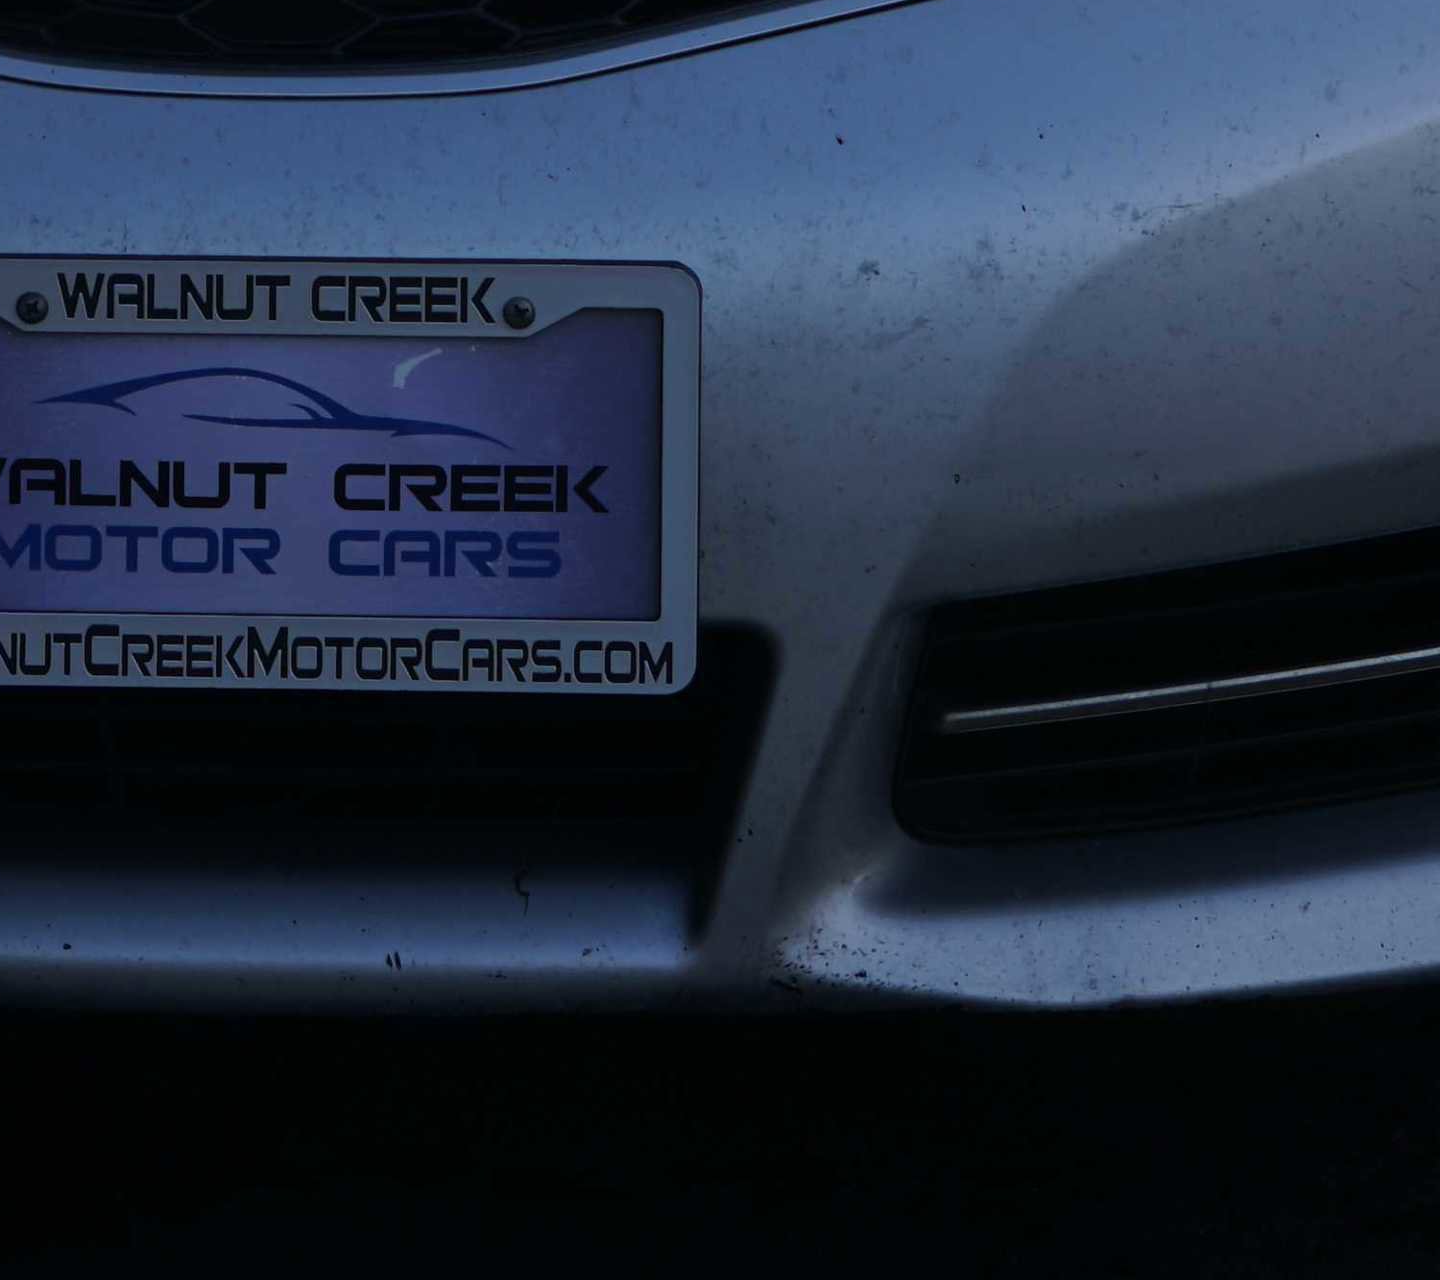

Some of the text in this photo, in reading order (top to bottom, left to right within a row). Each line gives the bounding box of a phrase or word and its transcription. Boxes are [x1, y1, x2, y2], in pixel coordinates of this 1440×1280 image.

[57, 272, 497, 324] WALNUT CREEK
[333, 463, 611, 513] CREEK
[328, 529, 563, 578] CARS
